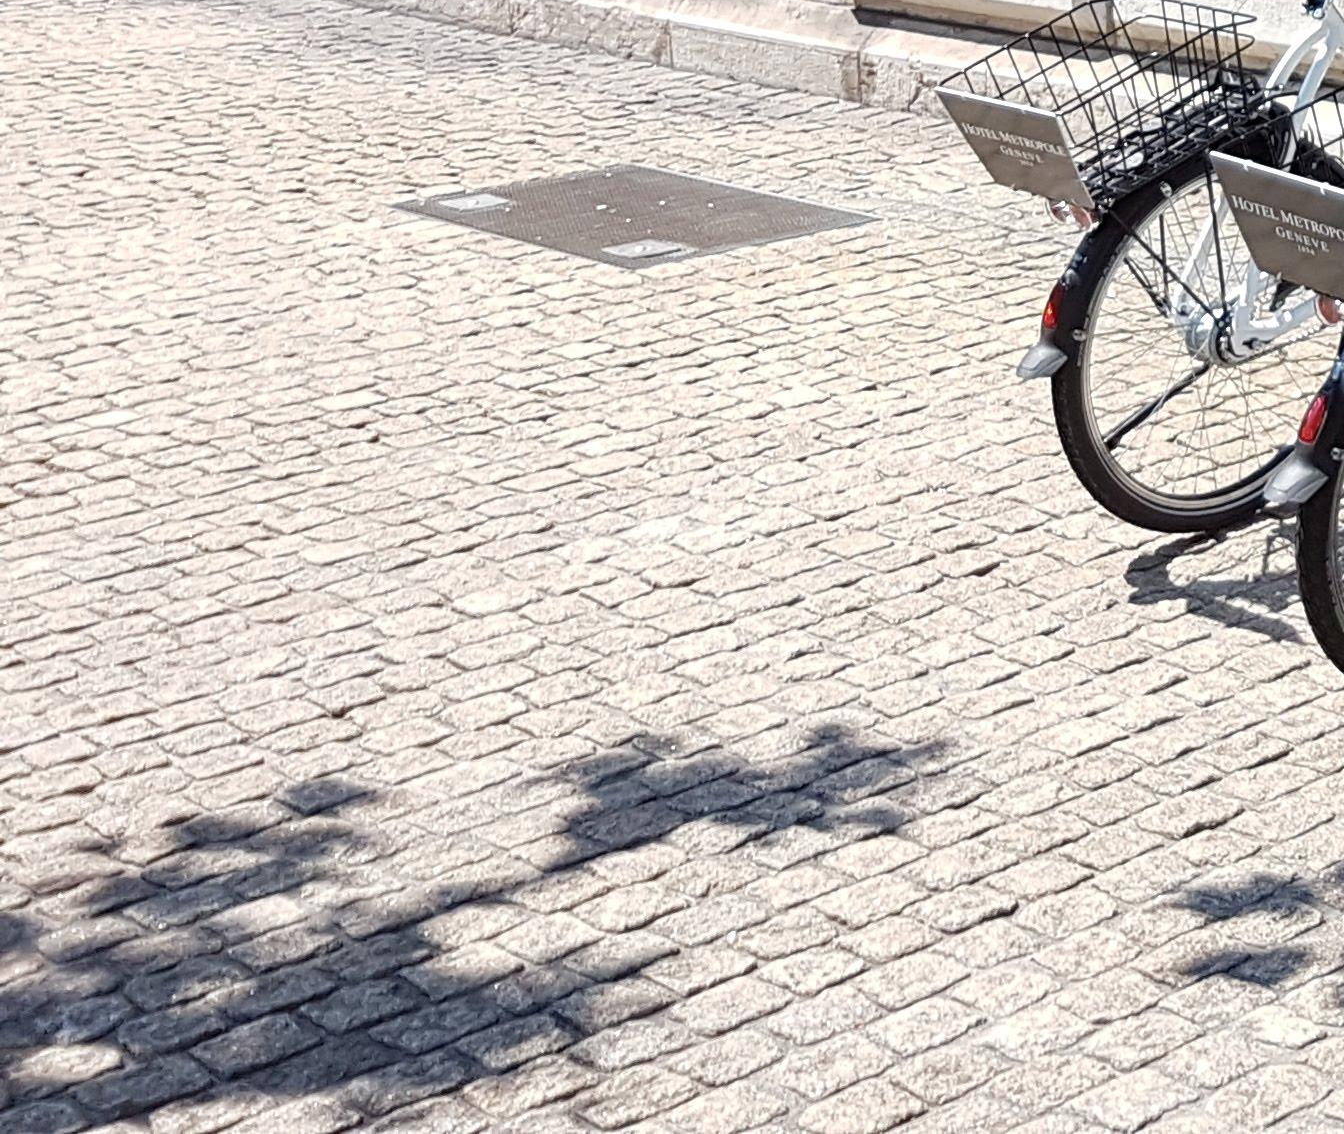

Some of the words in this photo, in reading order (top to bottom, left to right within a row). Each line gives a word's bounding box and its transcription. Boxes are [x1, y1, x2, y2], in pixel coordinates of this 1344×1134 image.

[960, 123, 999, 140] HOTEL
[1231, 195, 1279, 221] HOTEL
[1275, 226, 1330, 252] GENEVE
